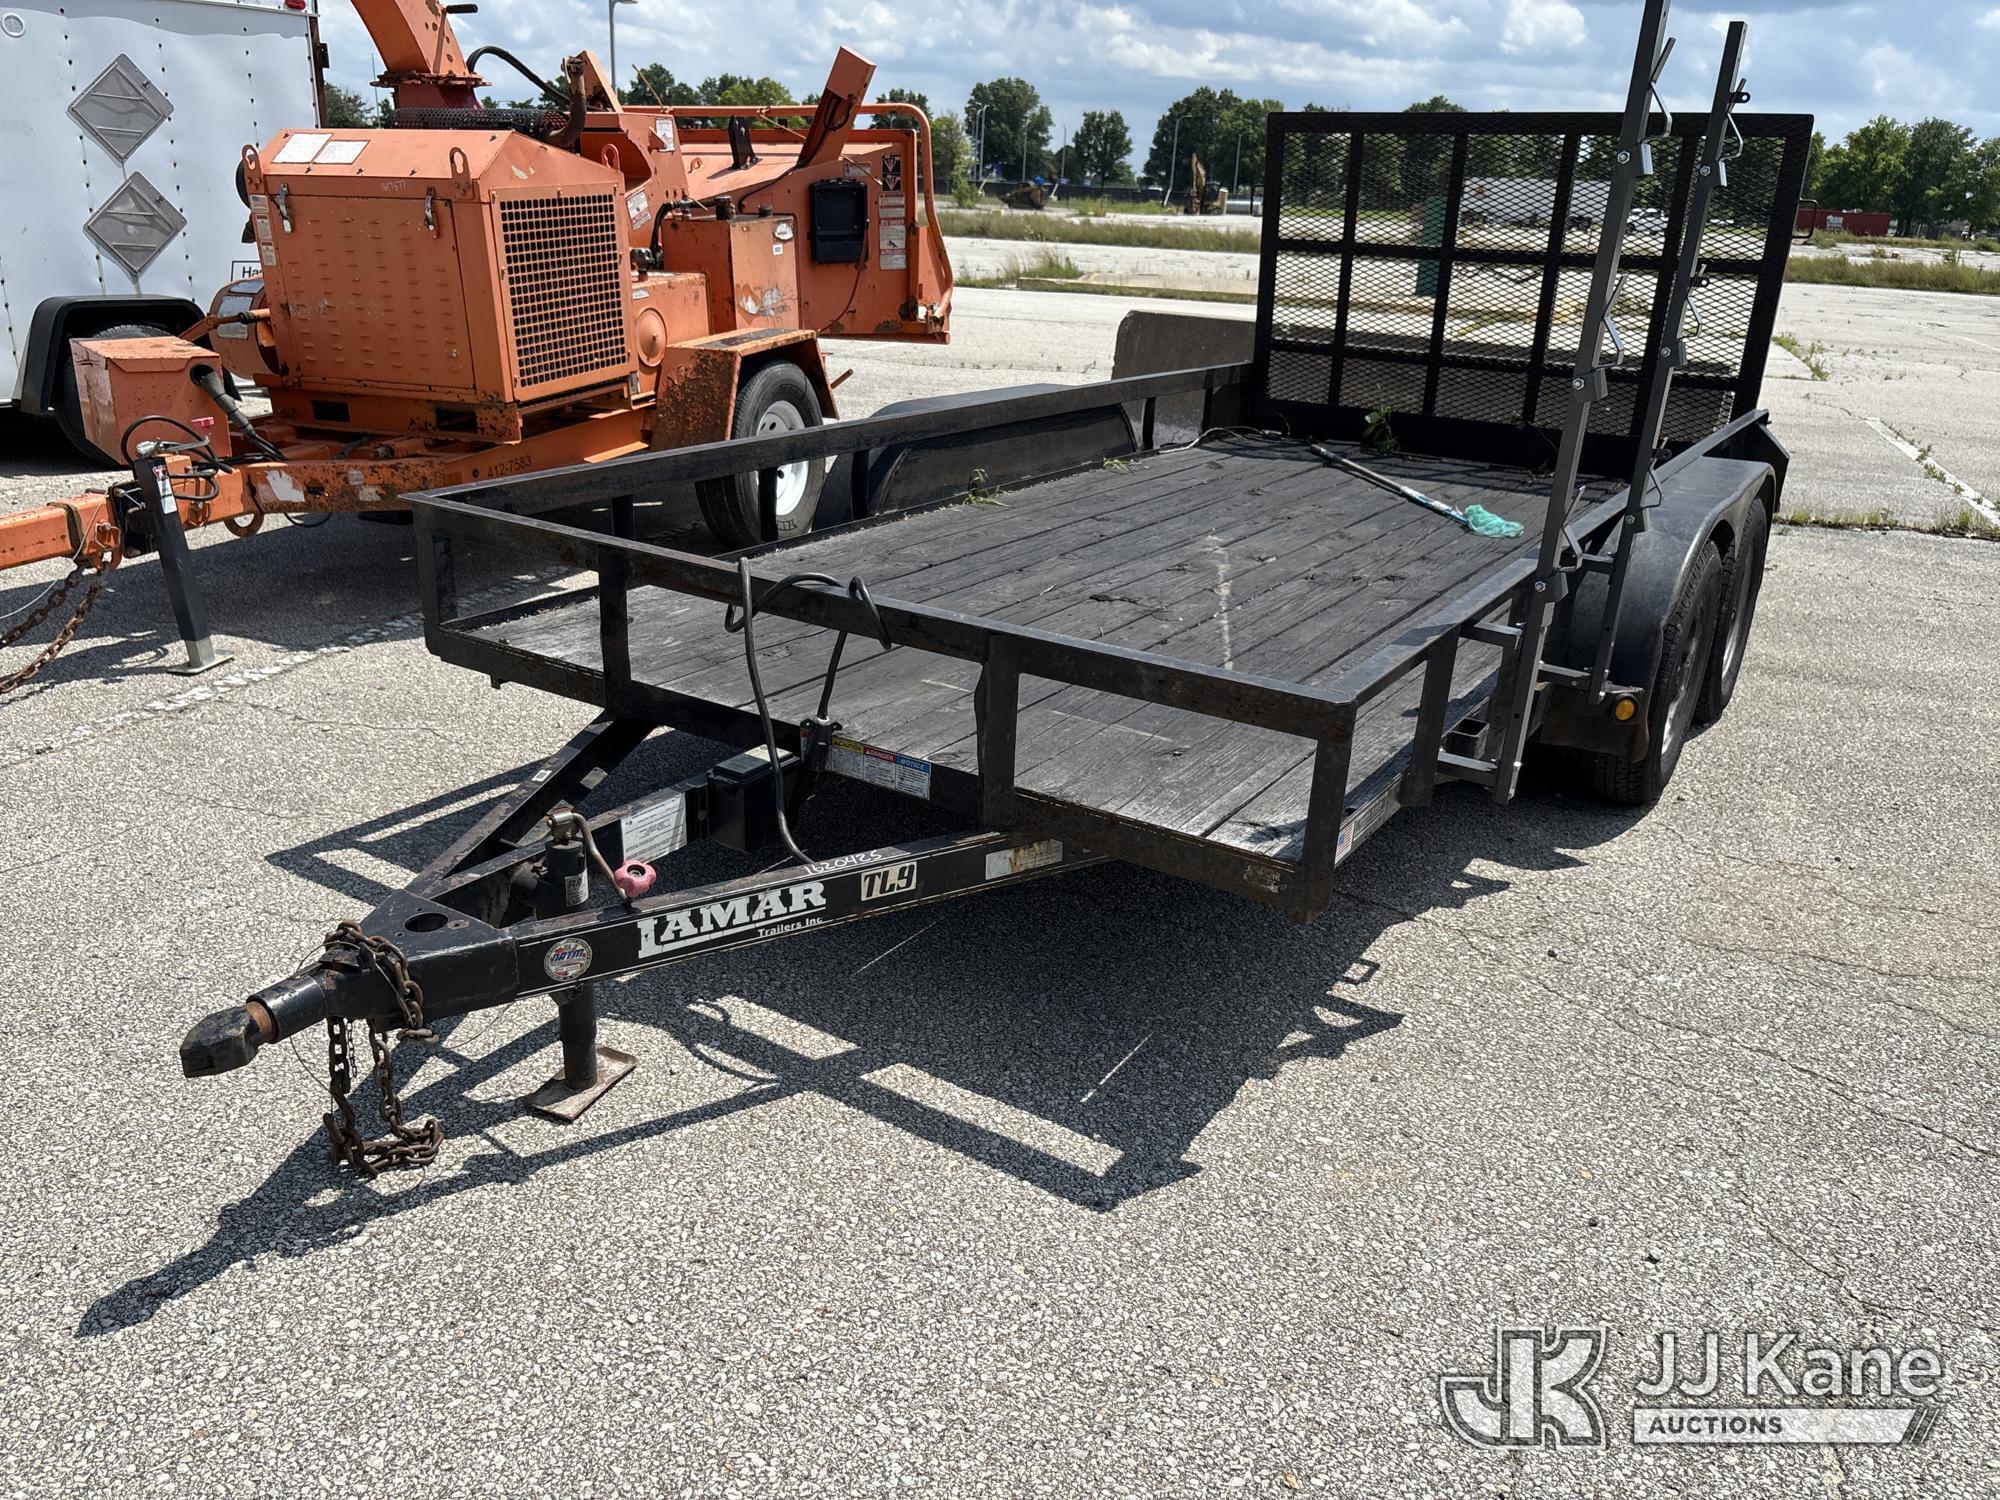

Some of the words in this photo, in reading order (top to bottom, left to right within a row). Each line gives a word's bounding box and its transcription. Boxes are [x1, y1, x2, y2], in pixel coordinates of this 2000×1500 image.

[487, 455, 532, 479] 412-7583
[900, 758, 925, 770] NOTICE
[804, 849, 882, 875] 1620425
[863, 864, 915, 898] TL9
[637, 881, 827, 959] LAMAR
[757, 921, 802, 938] Trailers
